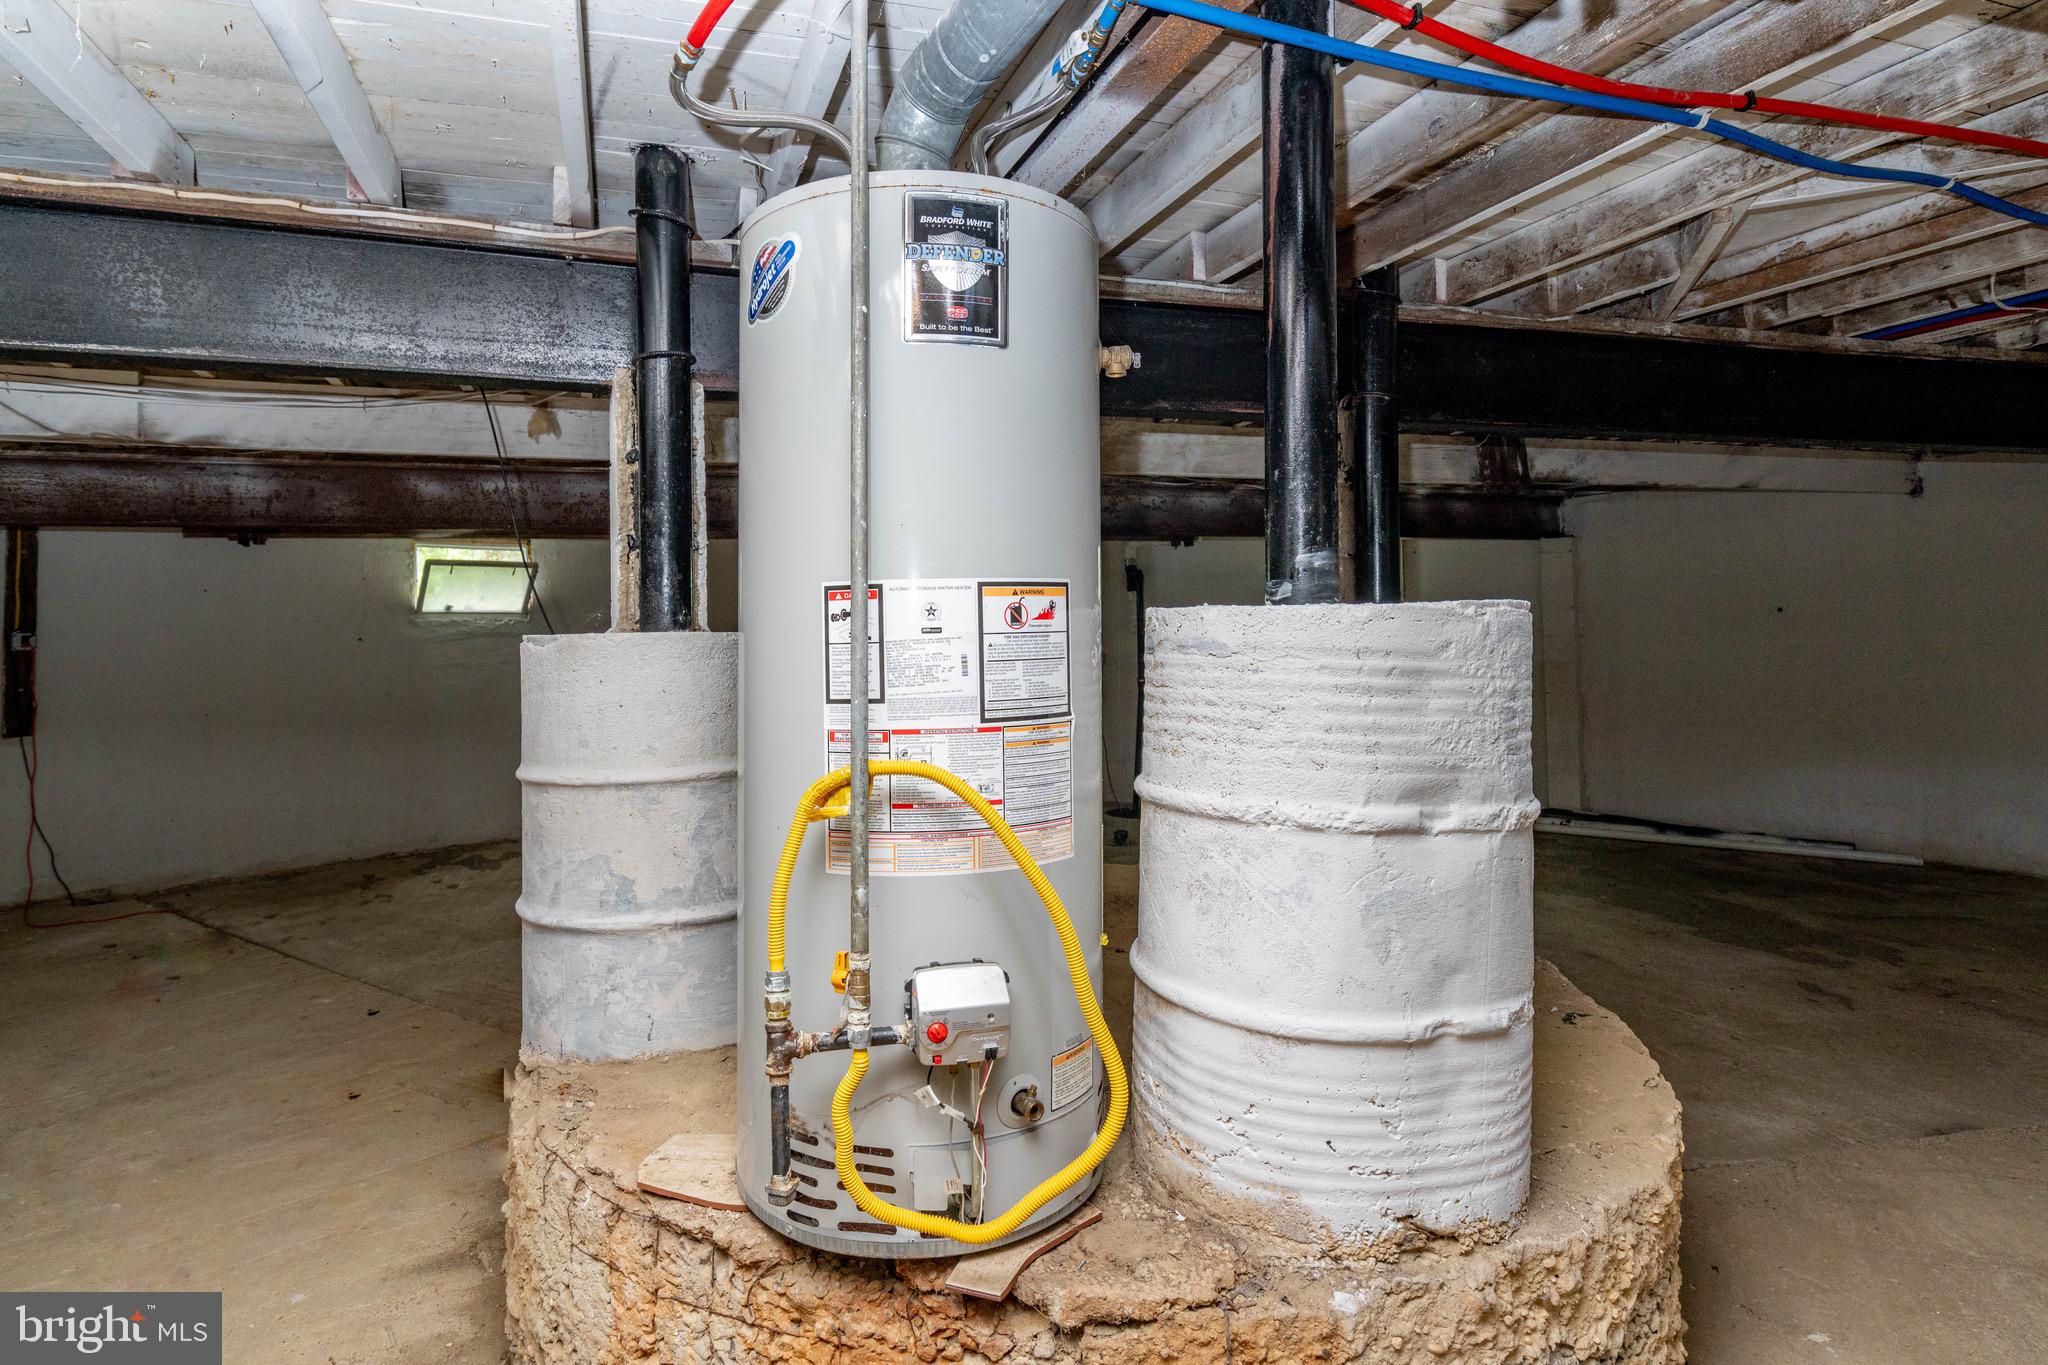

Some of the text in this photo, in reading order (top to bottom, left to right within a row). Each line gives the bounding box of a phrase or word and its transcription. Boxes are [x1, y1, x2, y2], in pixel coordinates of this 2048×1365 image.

[920, 215, 992, 229] BRADFORD WHITE
[905, 242, 1006, 267] DEFENDER
[948, 324, 958, 332] be
[974, 326, 992, 334] Best
